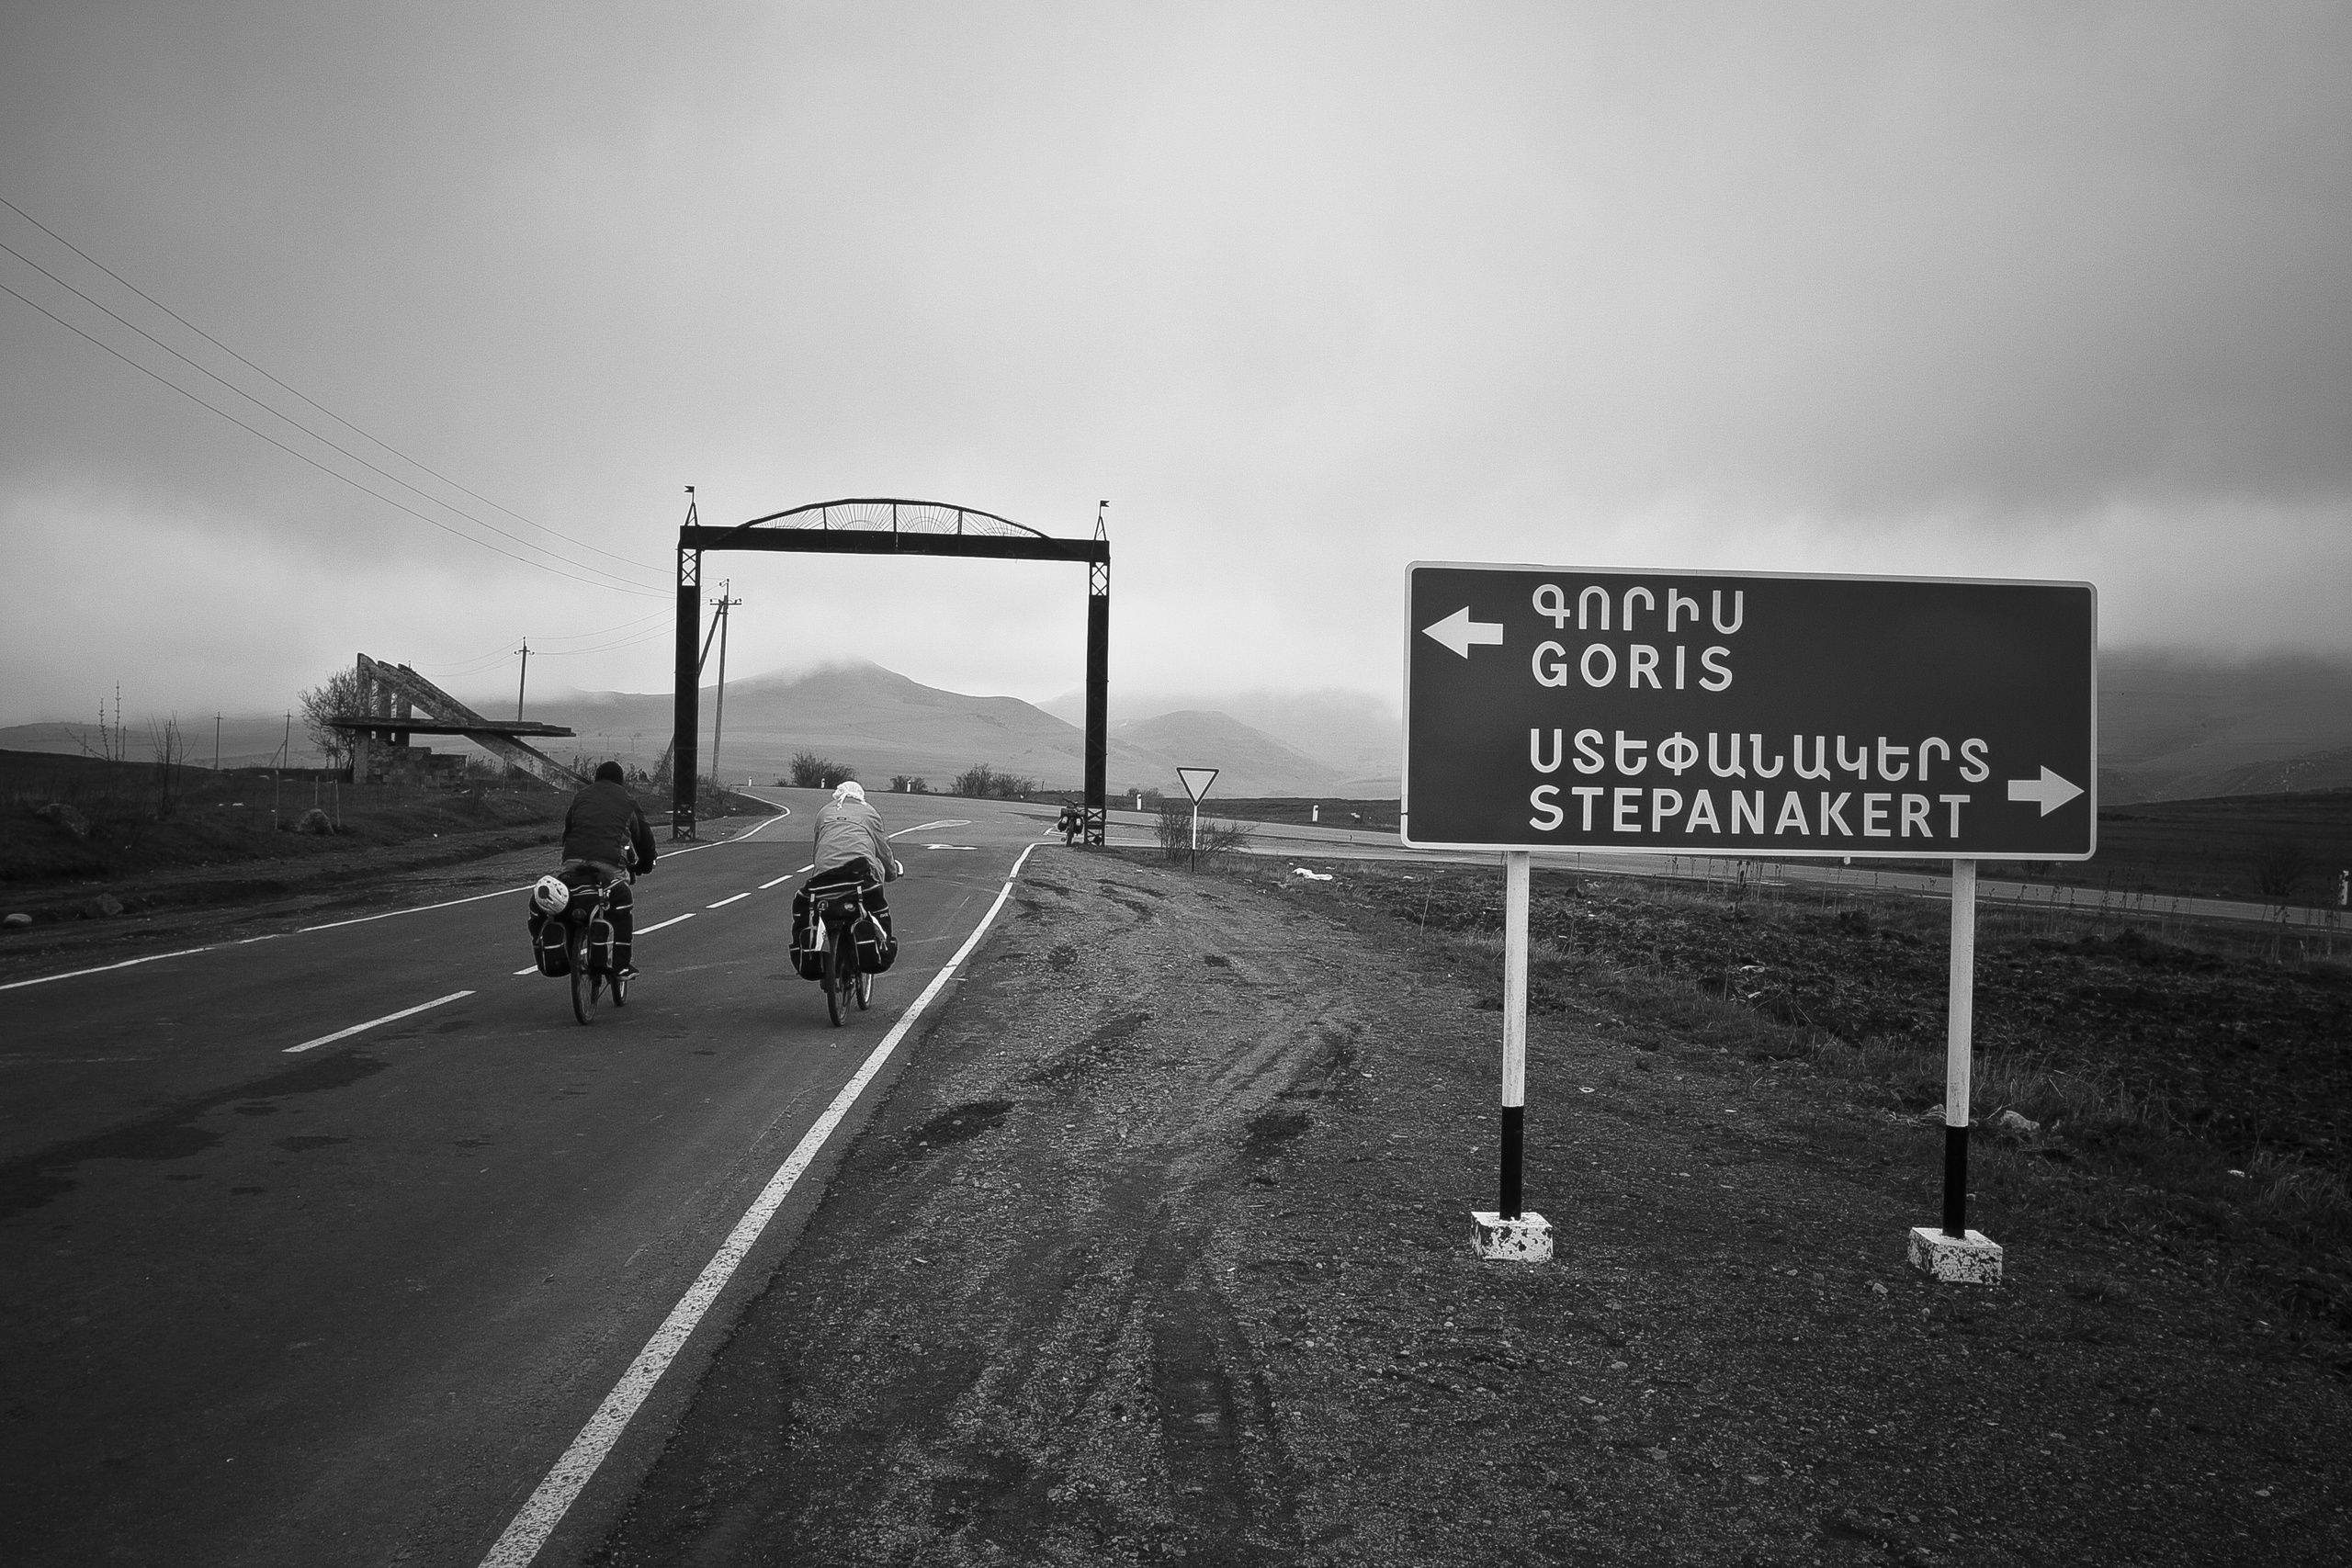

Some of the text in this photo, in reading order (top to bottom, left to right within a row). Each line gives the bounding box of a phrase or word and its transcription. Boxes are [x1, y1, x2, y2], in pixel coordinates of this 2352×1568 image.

[1532, 583, 1744, 635] ԳՈՐԻՍ
[1532, 640, 1733, 692] GORIS
[1530, 728, 1990, 783] ՍՏԵՓԱՆԱԿԵՐՏ
[1529, 784, 1971, 839] STEPANAKERT
